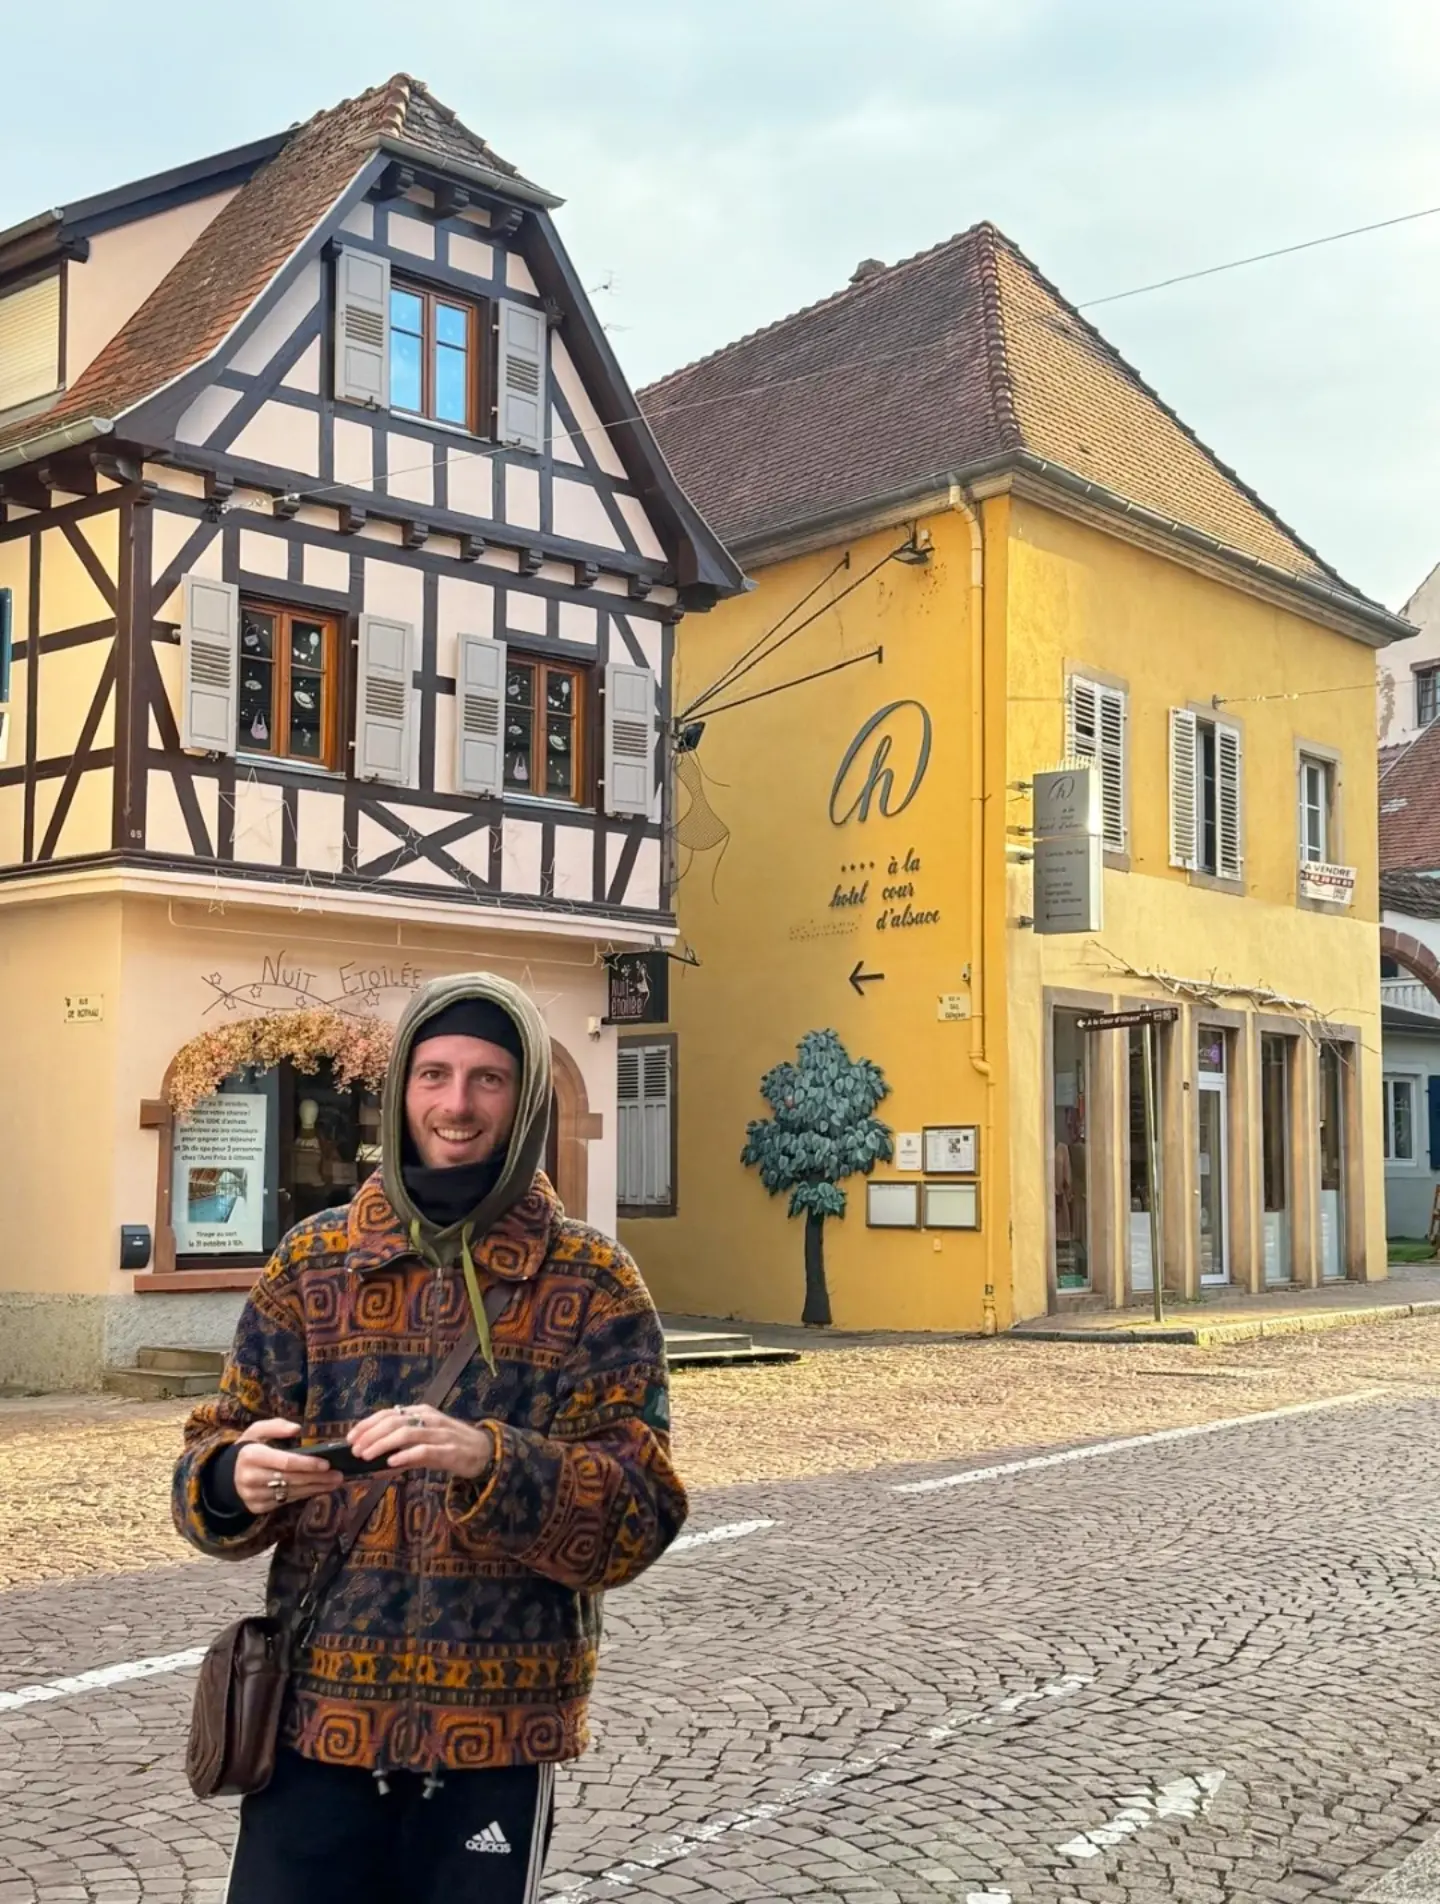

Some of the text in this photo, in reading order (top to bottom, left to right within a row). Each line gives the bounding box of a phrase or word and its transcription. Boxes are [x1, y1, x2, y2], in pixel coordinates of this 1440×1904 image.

[888, 847, 920, 874] à la
[1314, 864, 1351, 877] VENDRE
[828, 880, 869, 907] hotel
[882, 882, 915, 900] cour
[876, 903, 940, 930] d'alsace
[465, 1839, 512, 1854] adidas
